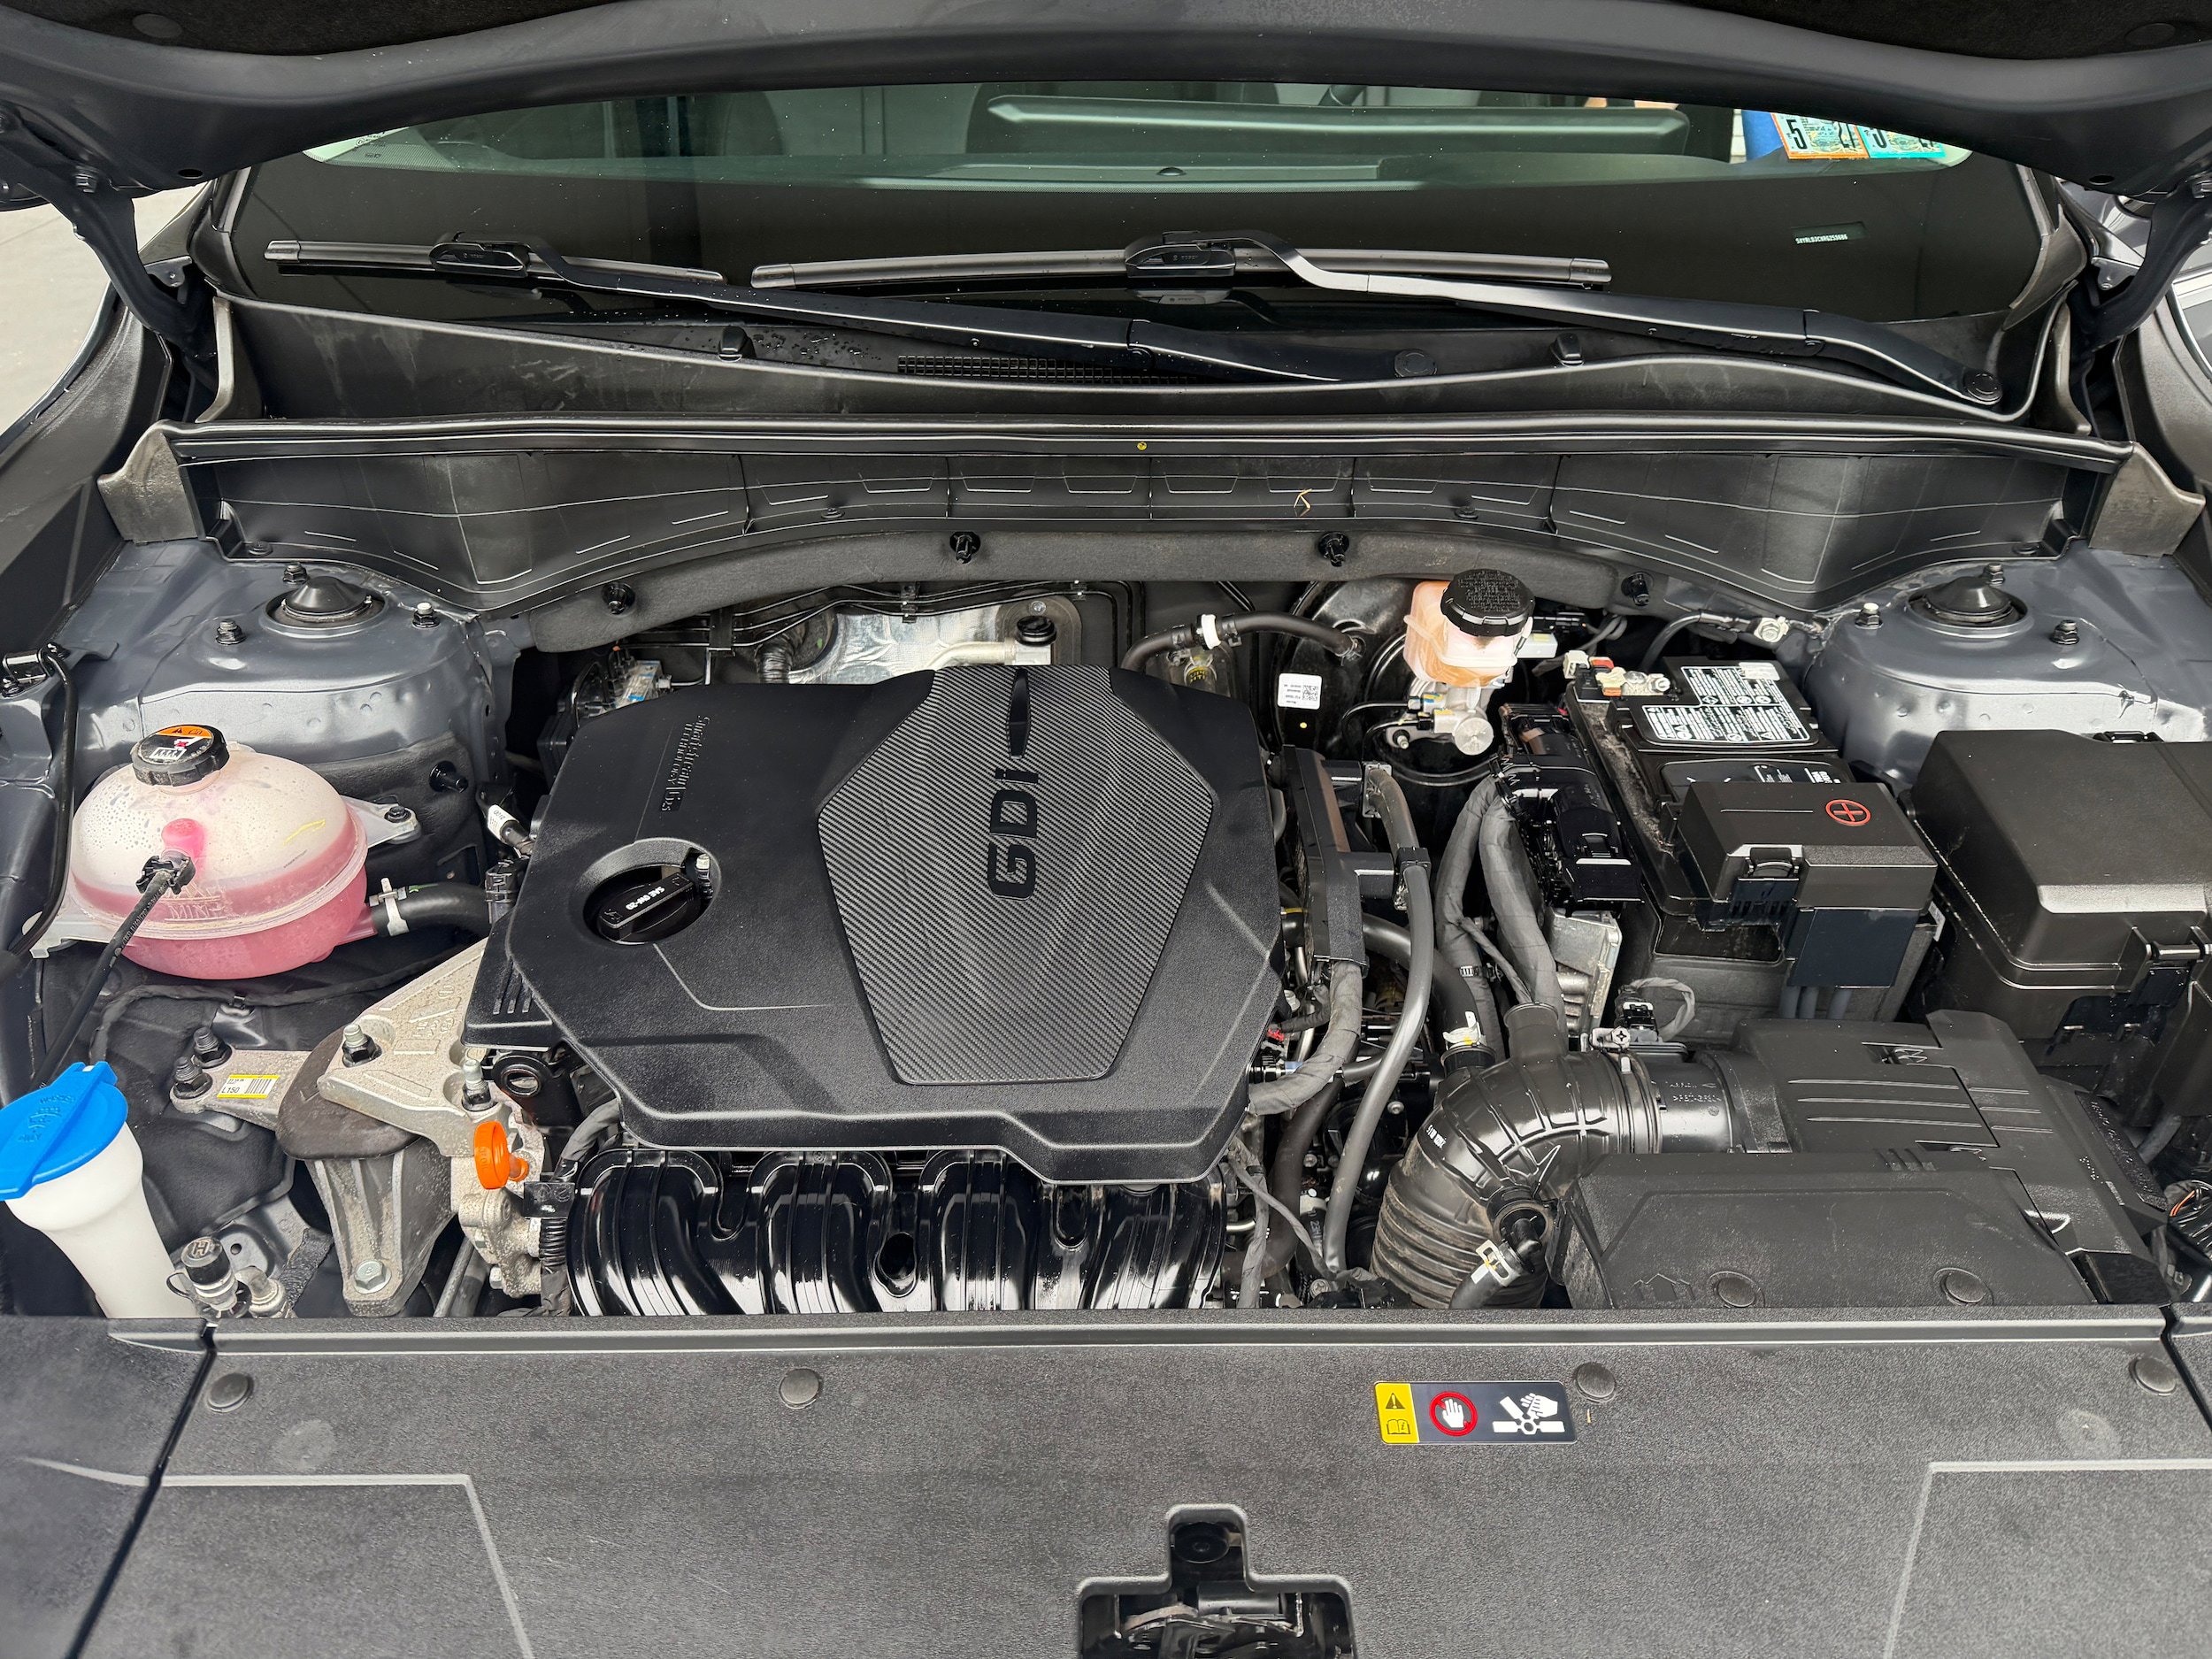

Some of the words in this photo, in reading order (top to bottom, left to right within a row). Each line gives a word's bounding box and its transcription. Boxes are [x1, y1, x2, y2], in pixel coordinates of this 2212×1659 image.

[1786, 119, 1808, 150] 5
[648, 886, 665, 897] SAE
[168, 904, 210, 919] MIN
[192, 1240, 210, 1256] H
